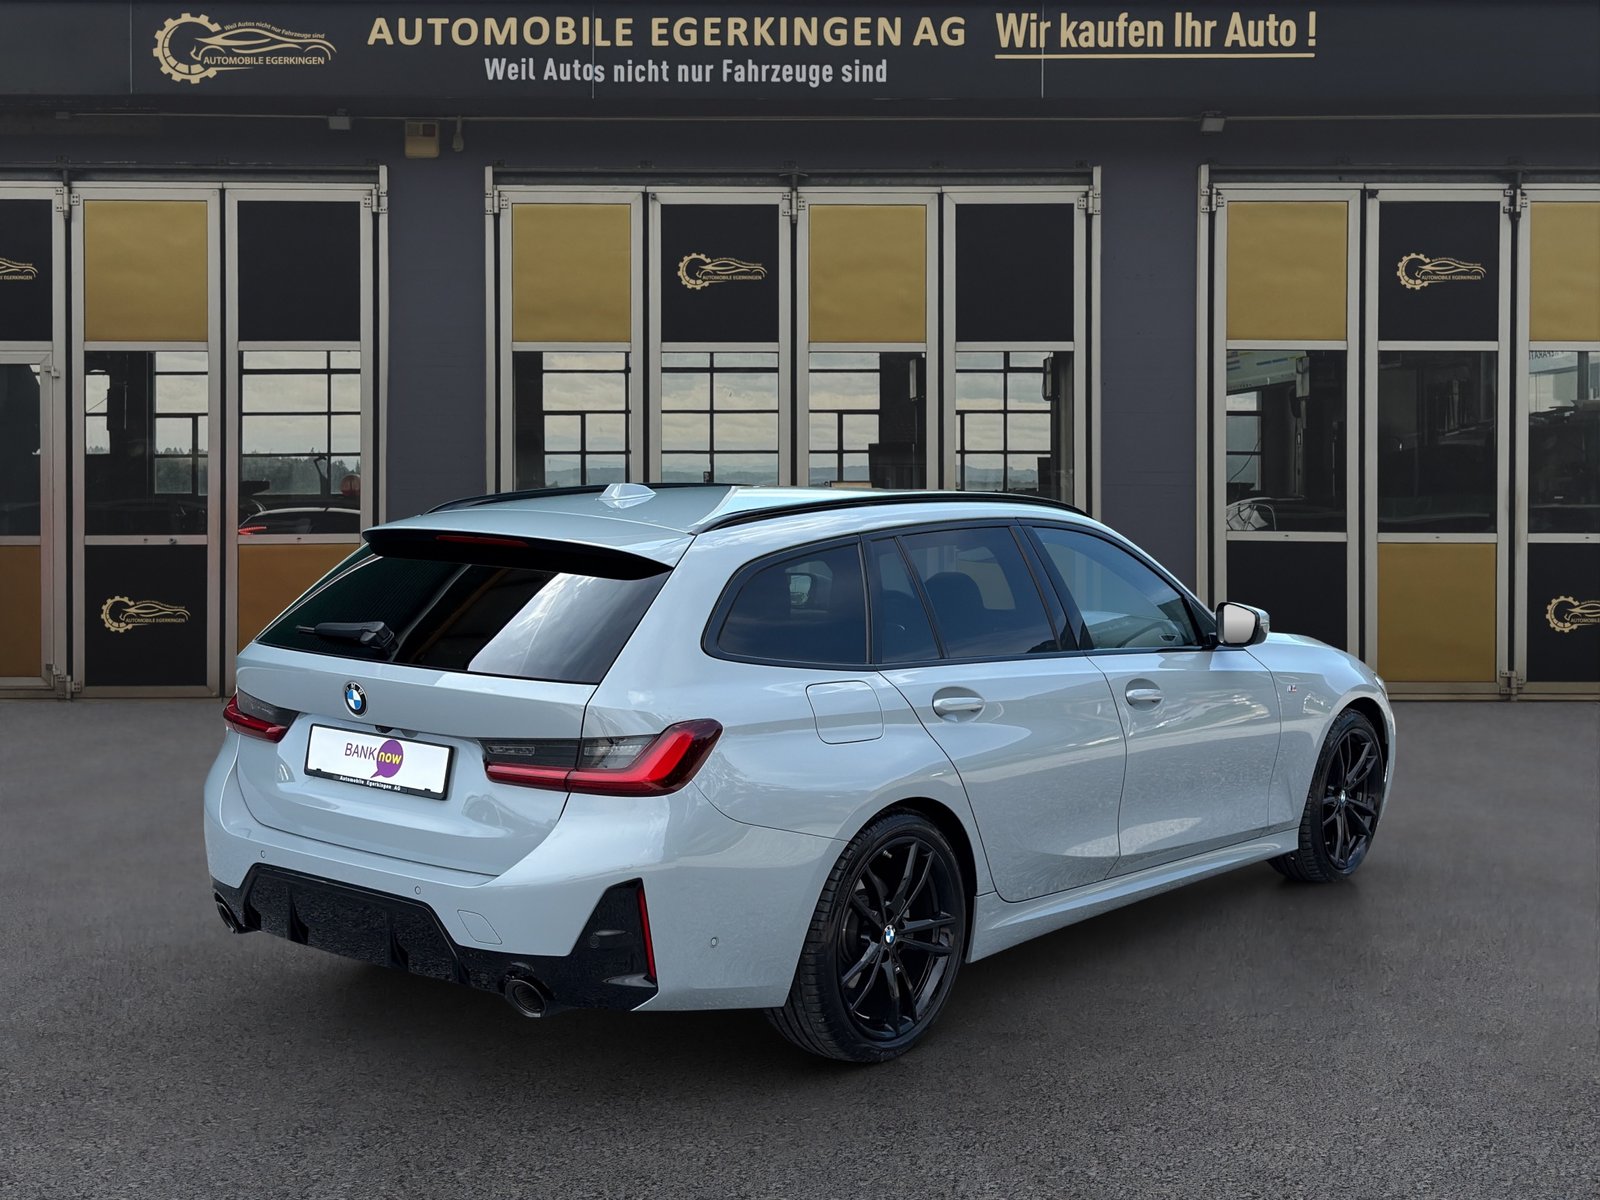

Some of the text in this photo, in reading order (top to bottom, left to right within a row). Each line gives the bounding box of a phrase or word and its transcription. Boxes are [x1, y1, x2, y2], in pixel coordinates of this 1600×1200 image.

[224, 22, 237, 31] Weil
[255, 22, 272, 30] nicht
[270, 25, 282, 33] nur
[281, 29, 312, 39] Fahrzeuge
[367, 16, 966, 47] AUTOMOBILE EGERKINGEN AG
[995, 11, 1317, 49] Wir kaufen Ihr Auto !
[203, 56, 325, 65] AUTOMOBILE EGERKINGEN
[484, 57, 887, 88] Weil Autos nicht nur Fahrzeuge sind
[345, 742, 402, 765] BANK now
[340, 775, 365, 784] Automobile
[366, 781, 392, 790] Egerkingen
